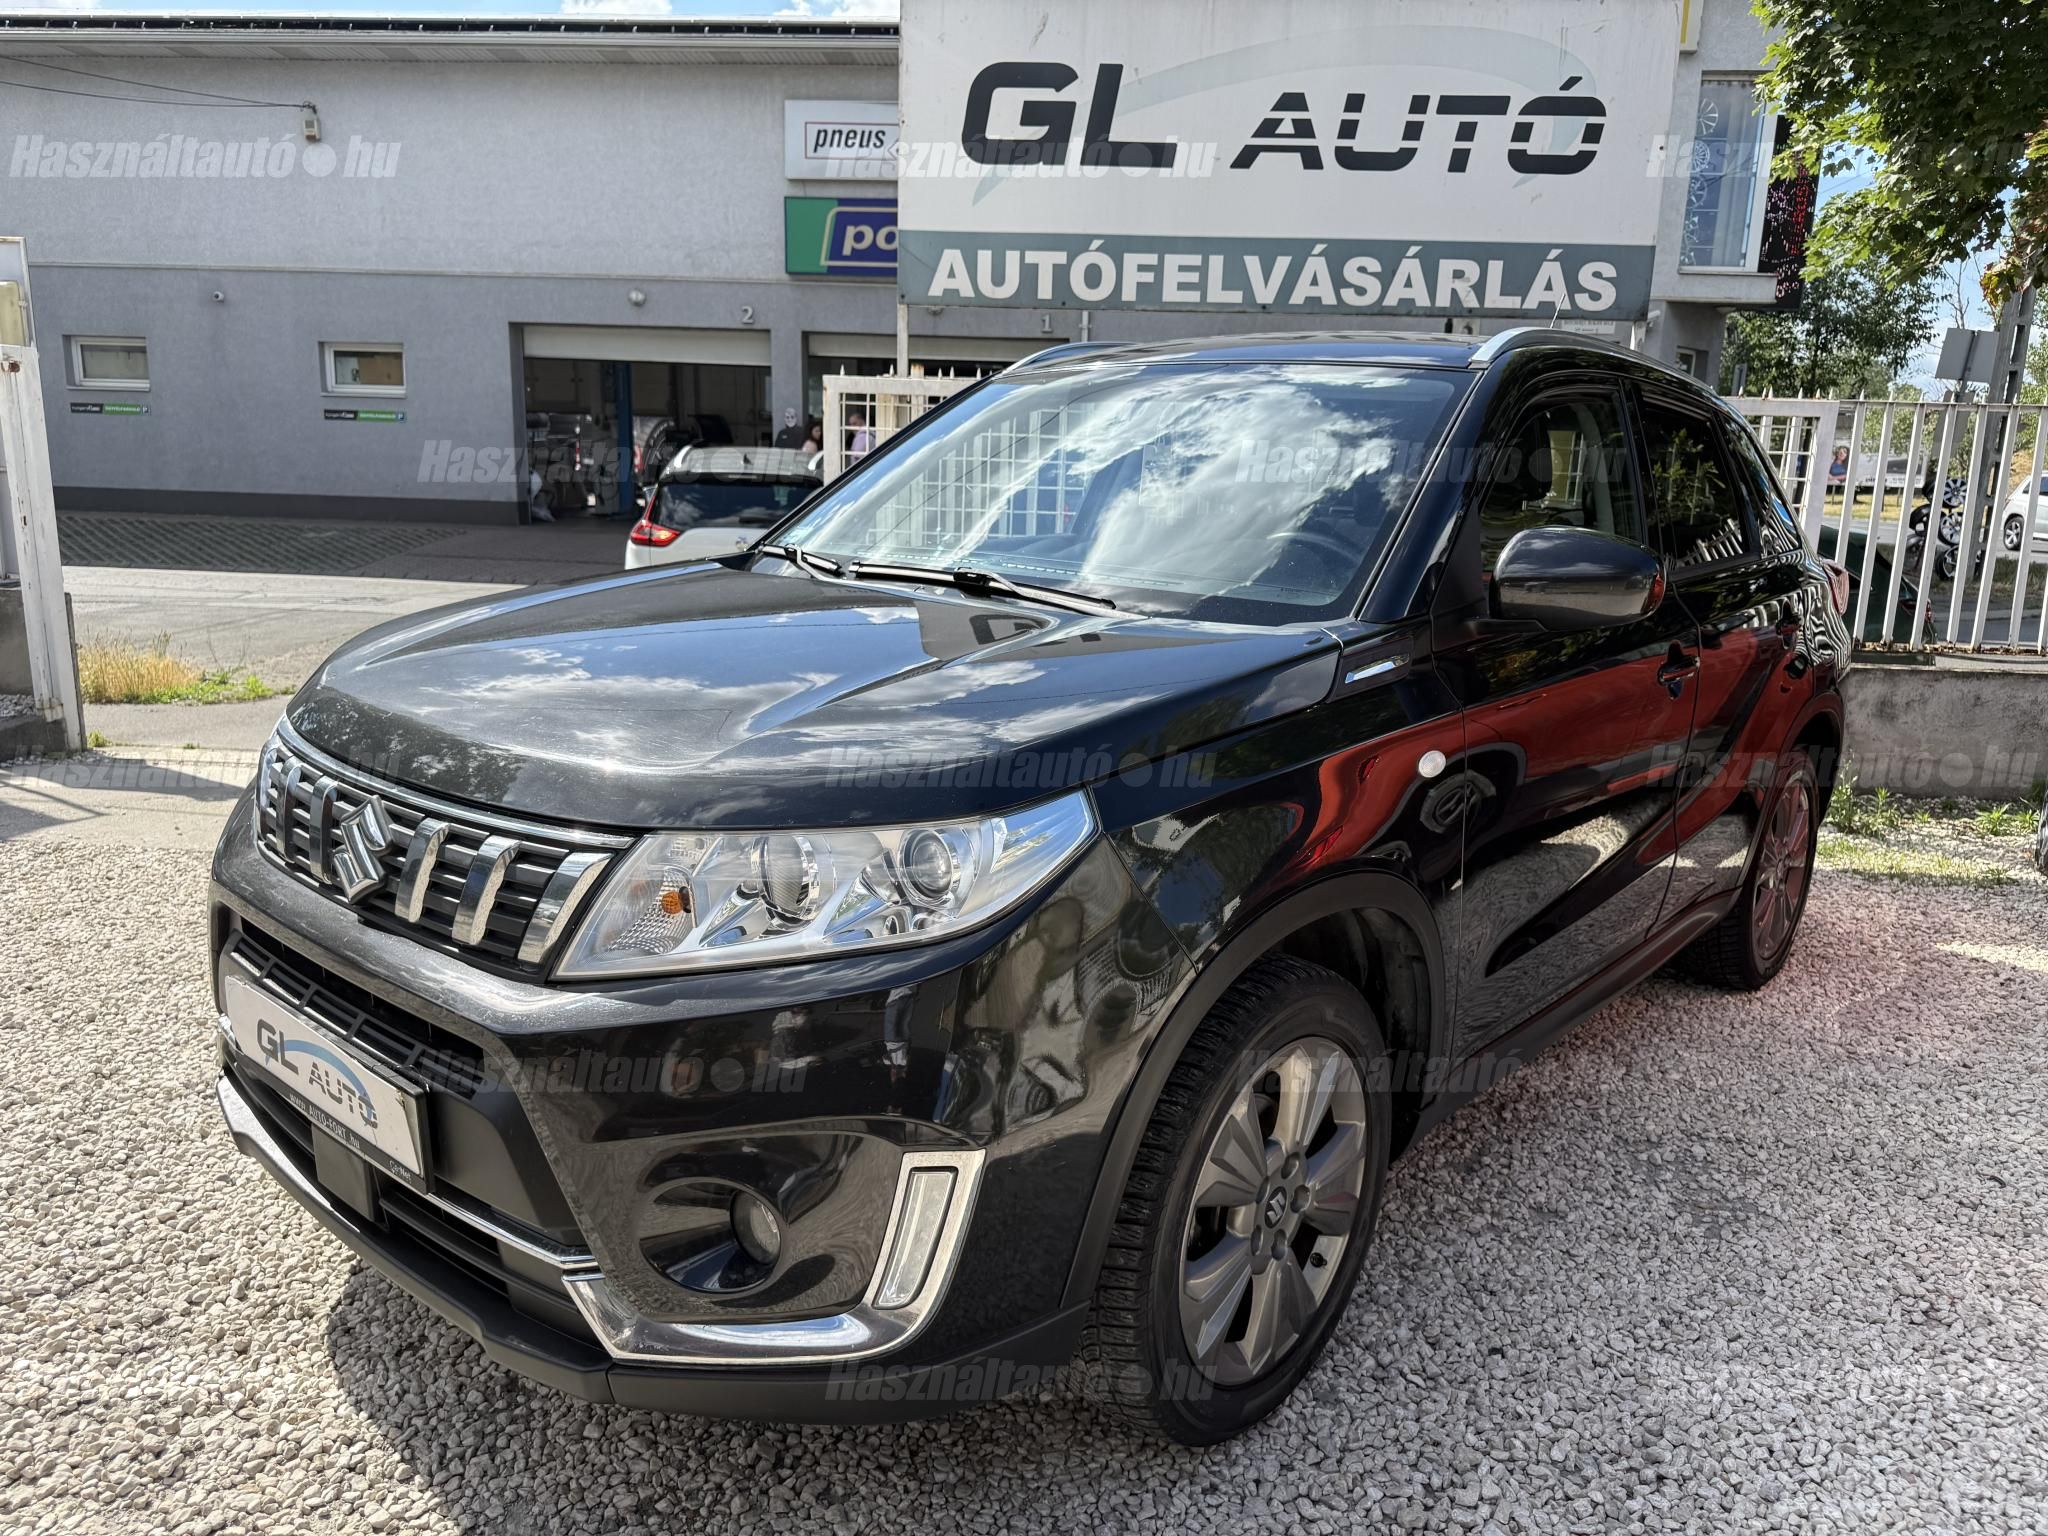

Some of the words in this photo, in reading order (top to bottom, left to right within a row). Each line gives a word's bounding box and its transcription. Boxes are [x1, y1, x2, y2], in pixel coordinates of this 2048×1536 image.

[961, 61, 1178, 169] GL
[1229, 76, 1607, 175] AUTÓ
[813, 127, 887, 153] pneus
[927, 239, 1619, 311] AUTÓFELVÁSÁRLÁS
[741, 305, 754, 324] 2
[1041, 313, 1054, 334] 1
[256, 1018, 300, 1076] GL
